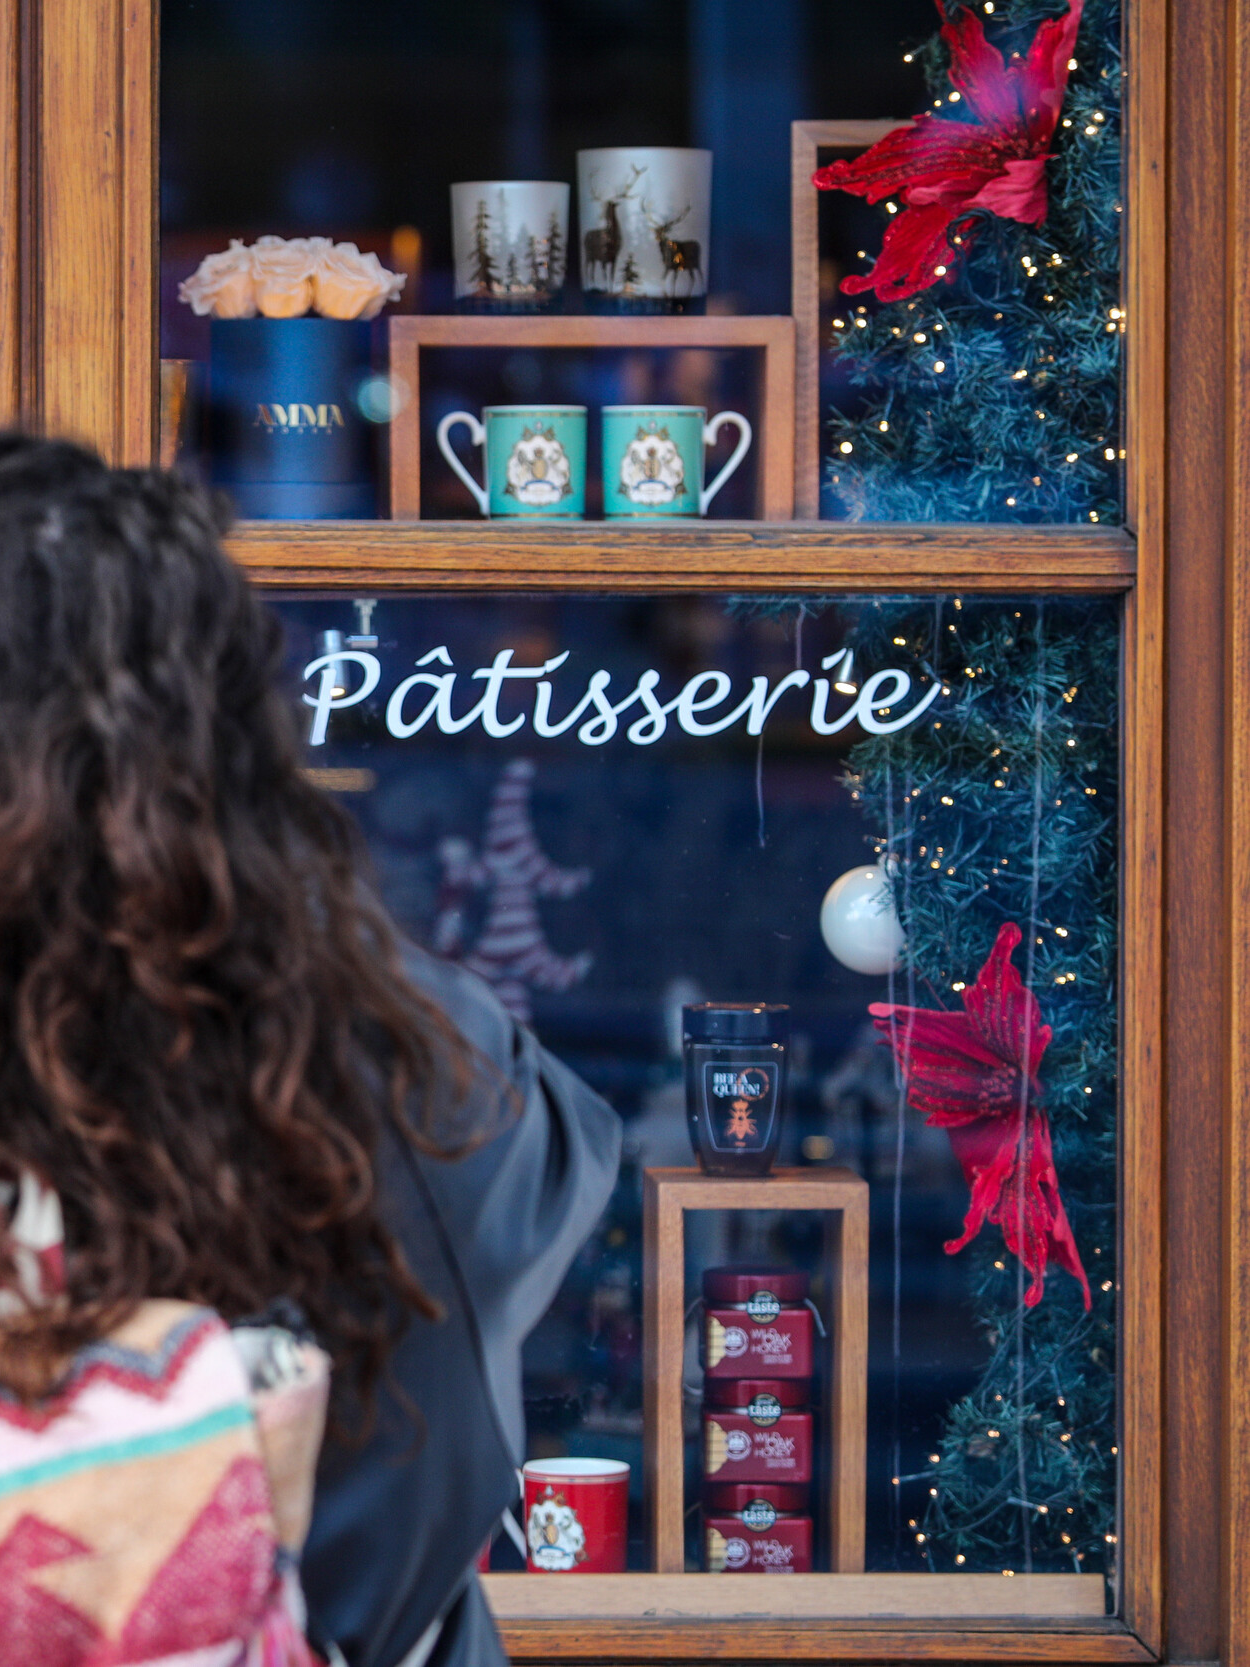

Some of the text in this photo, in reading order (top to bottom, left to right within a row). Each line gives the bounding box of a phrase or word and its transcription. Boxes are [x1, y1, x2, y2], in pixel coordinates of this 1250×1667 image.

[253, 402, 344, 427] AMMA
[302, 645, 940, 746] Pâtisserie
[713, 1072, 738, 1083] BEE
[713, 1083, 760, 1098] QUEEN!
[748, 1302, 780, 1313] taste
[761, 1332, 792, 1347] OAK
[751, 1343, 788, 1355] HONEY
[749, 1405, 781, 1416] taste
[764, 1435, 795, 1450] OAK
[753, 1446, 791, 1457] HONEY
[744, 1511, 776, 1522] taste
[763, 1543, 794, 1559] OAK
[753, 1554, 790, 1566] HONEY
